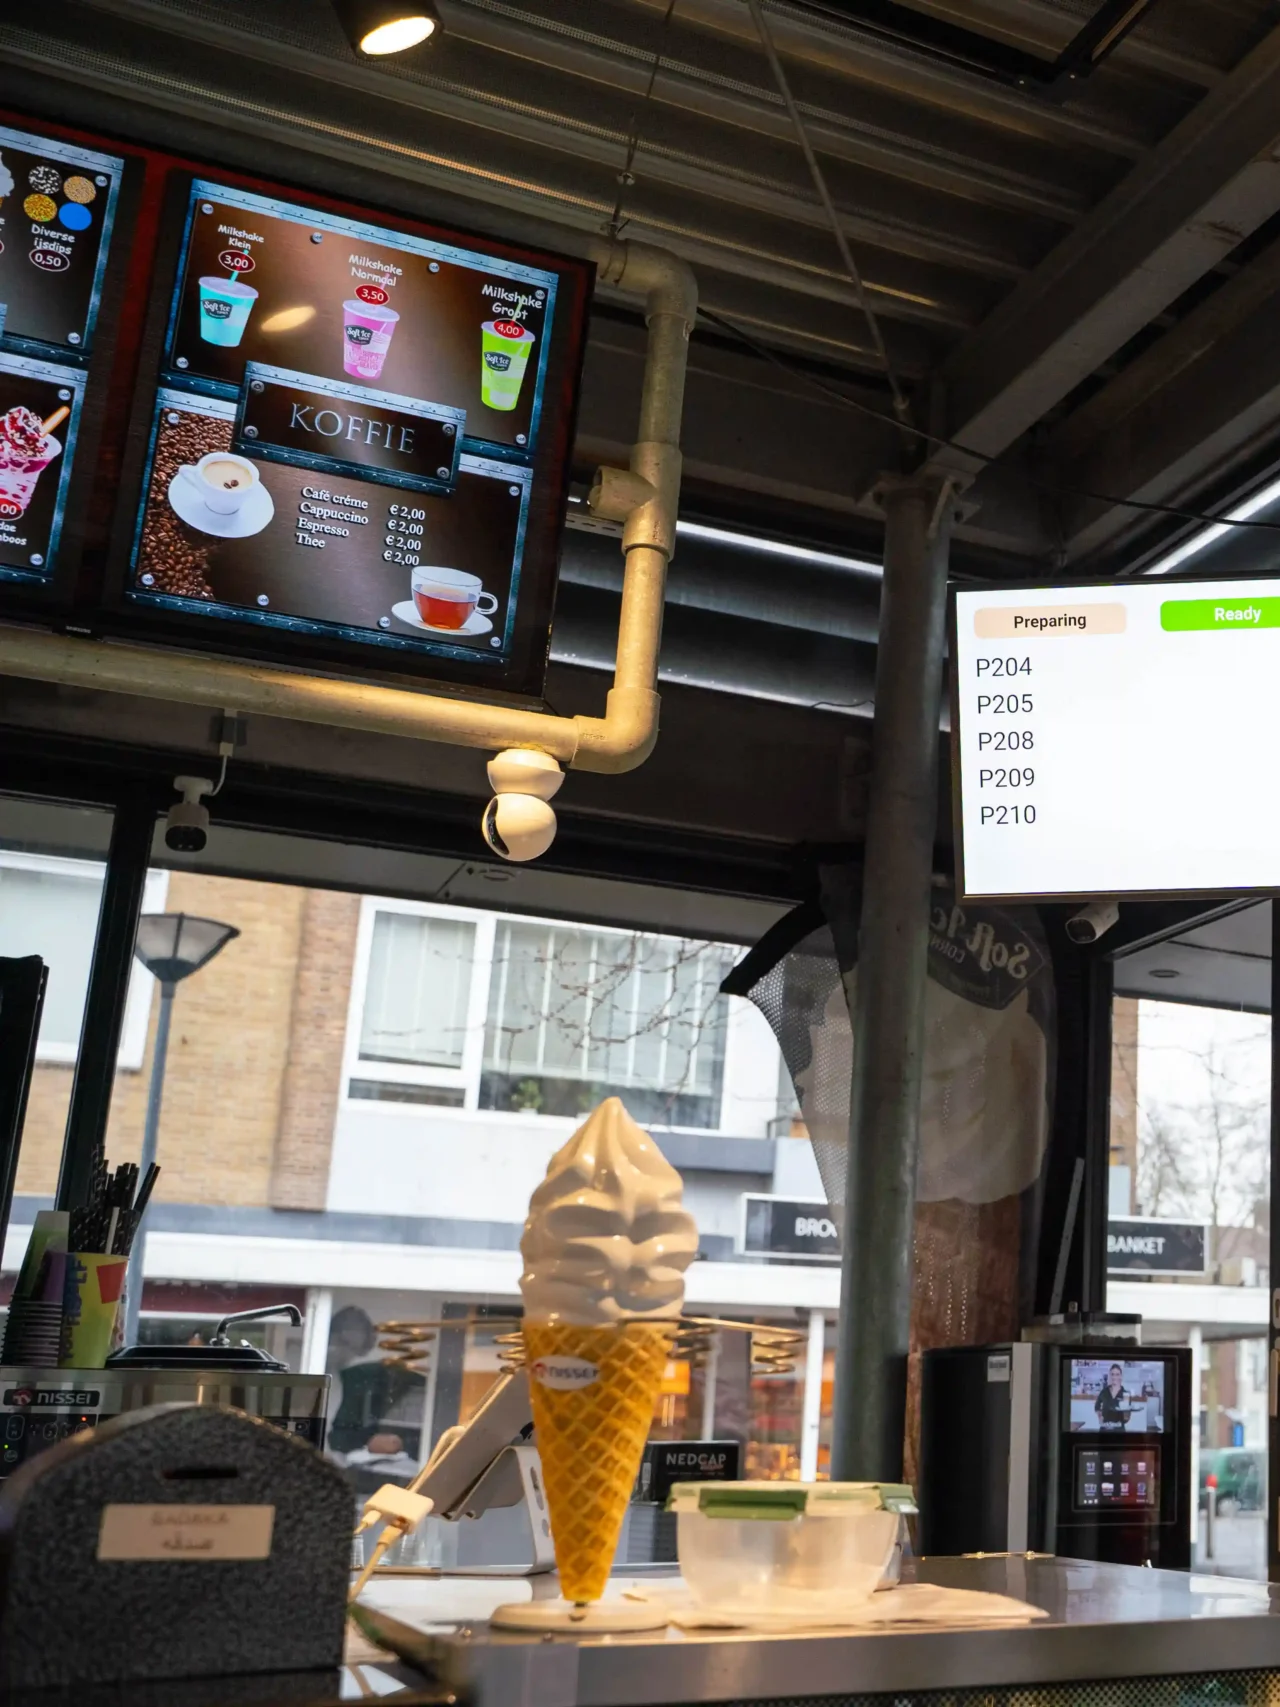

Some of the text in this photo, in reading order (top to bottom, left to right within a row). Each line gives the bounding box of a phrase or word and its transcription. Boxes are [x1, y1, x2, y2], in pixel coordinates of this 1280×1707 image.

[31, 223, 76, 243] Diverse
[217, 224, 265, 243] Milkshake
[34, 237, 72, 255] ijsdips
[228, 237, 252, 250] Klein
[34, 252, 62, 267] 0,50
[224, 254, 249, 268] 3,00
[348, 254, 403, 276] Milkshake
[351, 266, 397, 287] Normaal
[361, 288, 385, 302] 3,50
[481, 283, 543, 309] Milkshake
[492, 302, 528, 320] Groot
[497, 323, 519, 336] 4,00
[289, 402, 416, 454] KOFFIE
[301, 486, 331, 501] Café
[300, 501, 369, 525] Cappuccino
[400, 506, 426, 521] 2,00
[297, 517, 350, 538] Espresso
[398, 521, 424, 536] 2,00
[296, 532, 326, 548] Thee
[396, 536, 422, 551] 2,00
[394, 552, 420, 566] 2,00
[1013, 613, 1087, 630] Preparing
[1213, 606, 1262, 624] Ready
[976, 656, 1033, 677] P204
[977, 693, 1034, 714] P205
[978, 730, 1034, 751] P208
[979, 767, 1035, 788] P209
[980, 804, 1036, 825] P210
[795, 1216, 838, 1238] BRO
[1106, 1234, 1166, 1255] BANKET
[37, 1392, 92, 1404] NISSEI
[666, 1452, 727, 1466] NEDCAP
